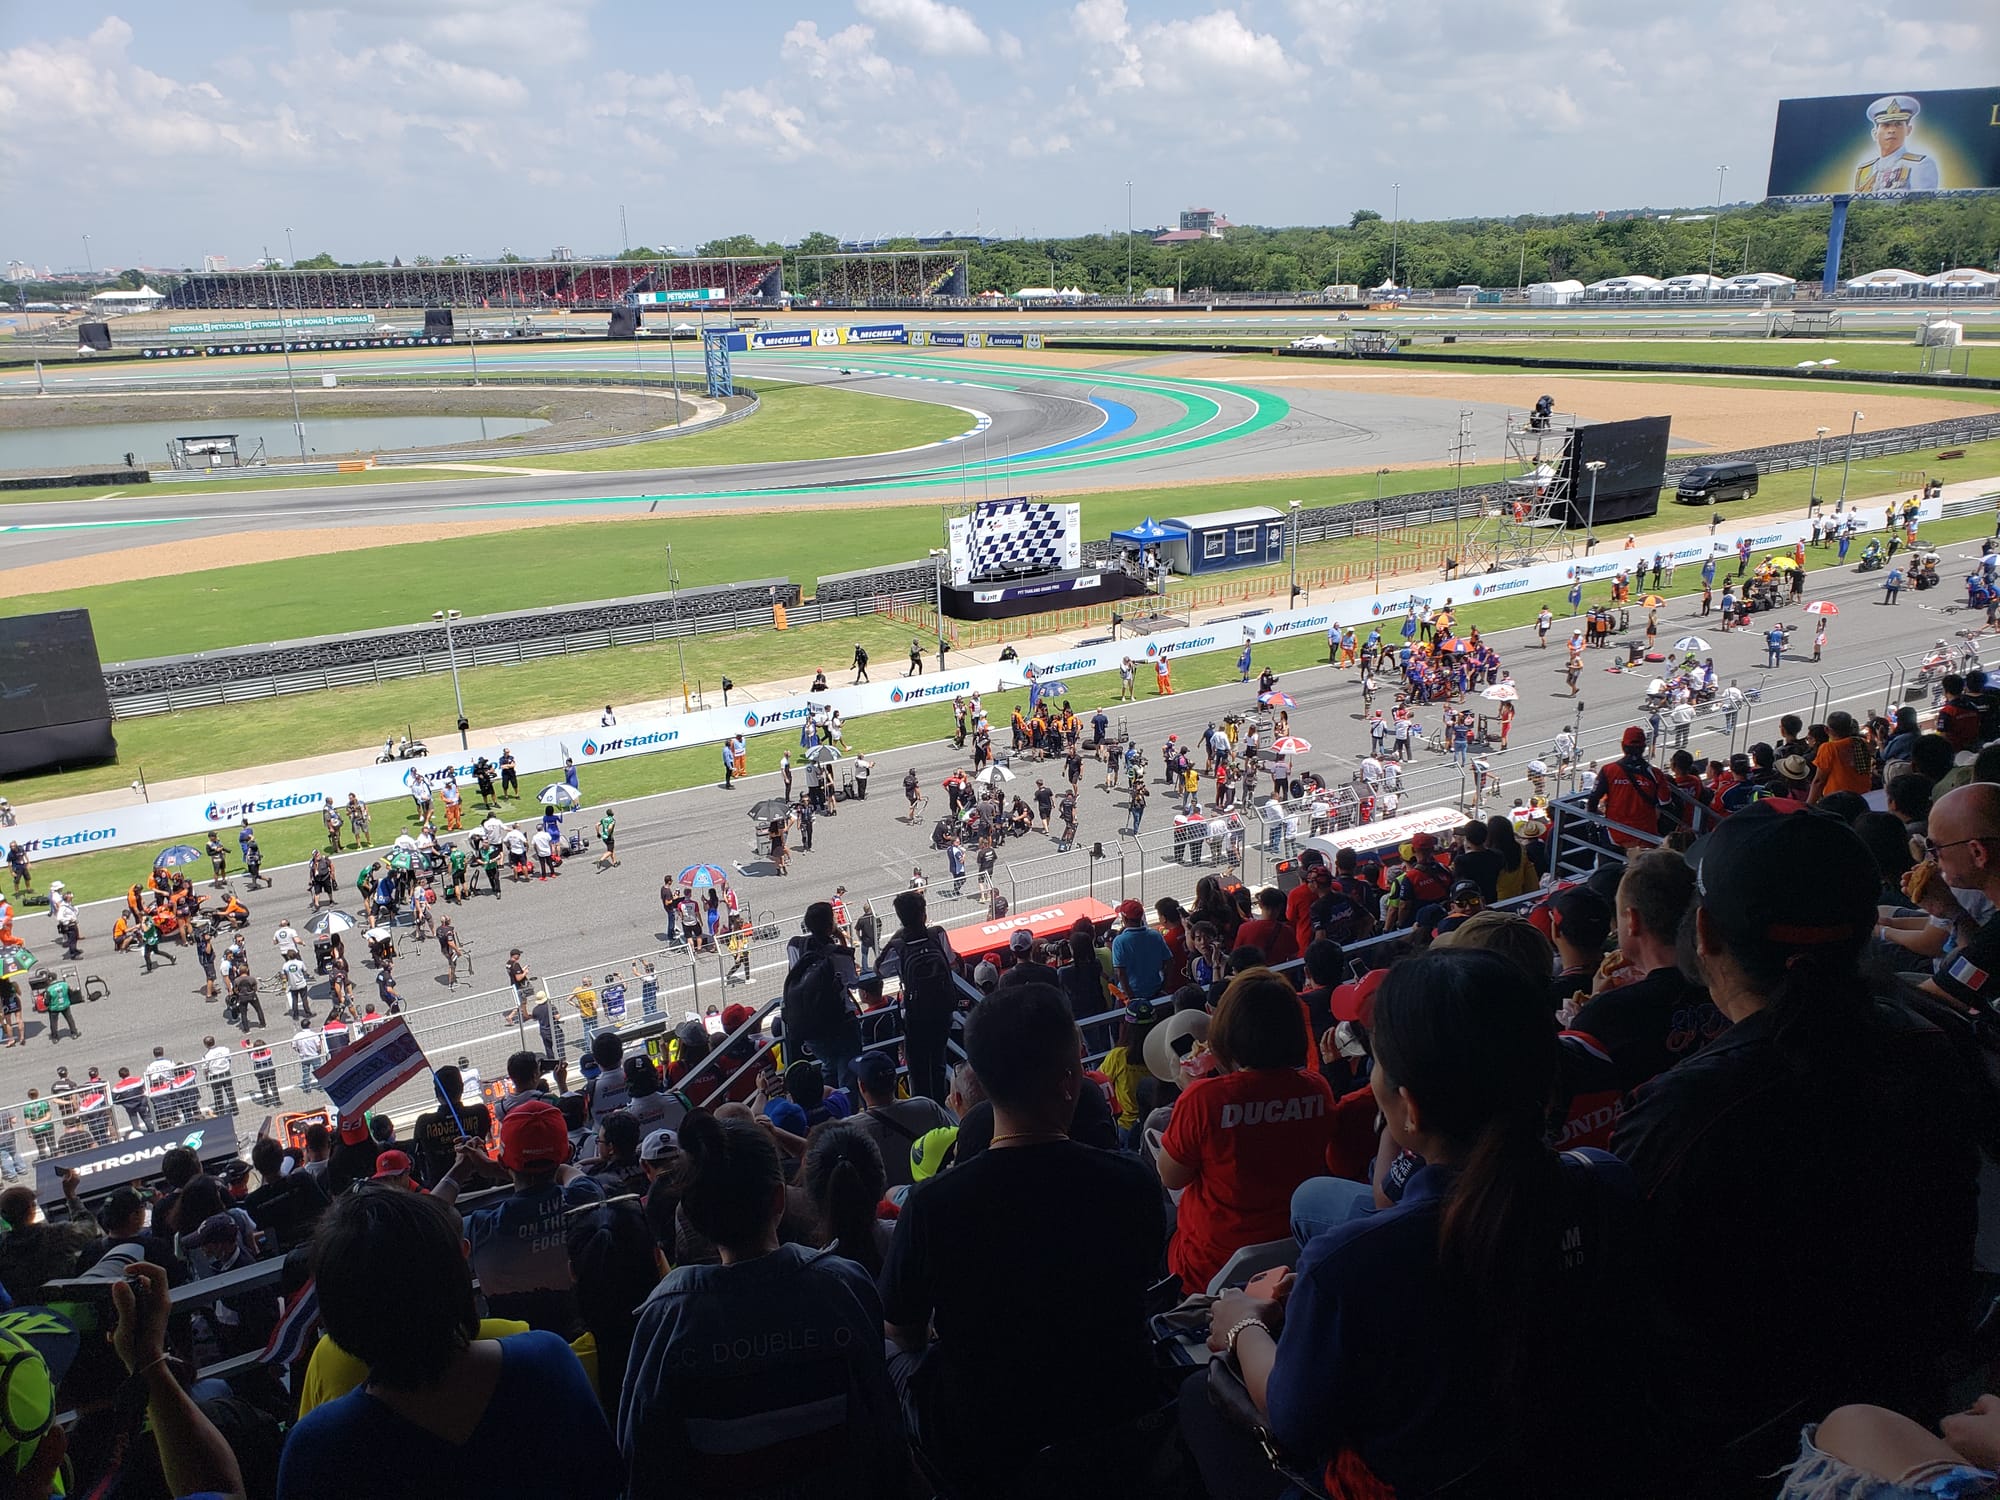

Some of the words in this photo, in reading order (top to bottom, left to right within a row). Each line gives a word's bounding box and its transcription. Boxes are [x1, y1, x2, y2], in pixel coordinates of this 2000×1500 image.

[667, 291, 699, 301] PETRONAS
[170, 325, 203, 333] PETRONAS
[210, 323, 244, 331] PETRONAS
[251, 320, 285, 329] PETRONAS
[293, 318, 326, 326] PETRONAS
[334, 316, 367, 324] PETRONAS
[765, 335, 810, 346] MICHELIN
[860, 329, 902, 339] MICHELIN
[937, 336, 964, 345] MICHELIN
[1674, 547, 1703, 559] station
[1593, 562, 1619, 574] tation
[1482, 582, 1497, 596] ptt
[1496, 577, 1530, 592] station
[1382, 602, 1398, 615] ptt
[1274, 623, 1290, 635] ptt
[1290, 615, 1328, 630] station
[1158, 643, 1176, 657] ptt
[1176, 636, 1215, 651] station
[1054, 657, 1097, 674] station
[904, 687, 924, 702] ptt
[924, 679, 970, 697] station
[760, 711, 782, 727] ptt
[599, 738, 623, 755] ptt
[622, 729, 679, 748] station
[255, 790, 323, 813] station
[1401, 812, 1464, 833] PRAMAC
[41, 826, 117, 850] station
[1336, 828, 1402, 849] PRAMAC
[981, 908, 1066, 936] DUCATI
[1221, 1094, 1325, 1129] DUCATI
[519, 1224, 539, 1239] ON
[544, 1215, 568, 1231] THE
[532, 1232, 568, 1253] EDGE
[711, 1327, 819, 1363] DOUBLE
[832, 1325, 853, 1347] O
